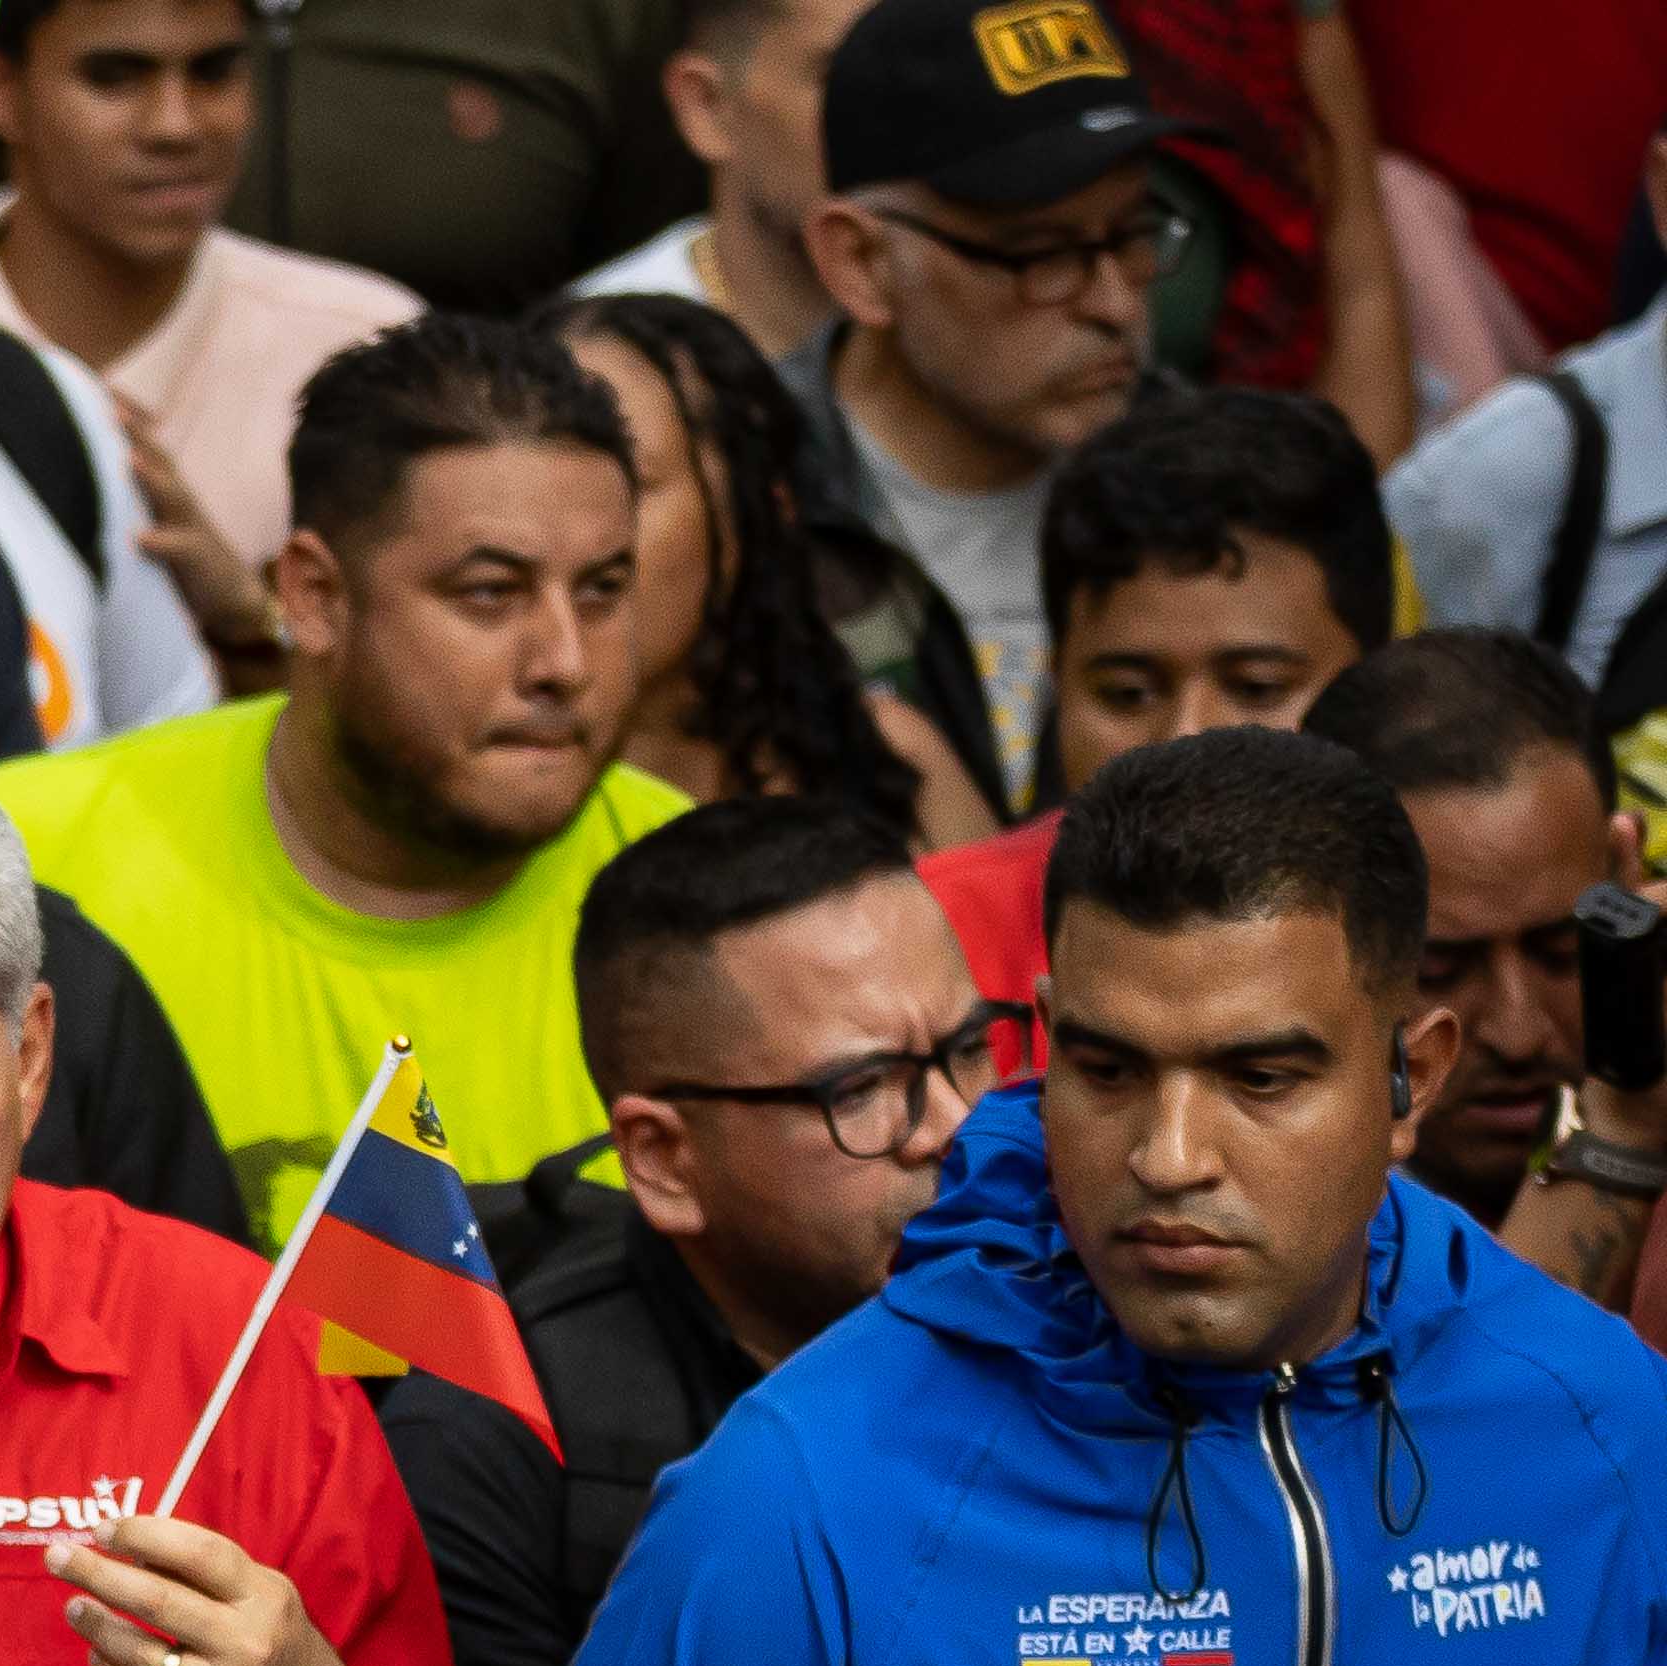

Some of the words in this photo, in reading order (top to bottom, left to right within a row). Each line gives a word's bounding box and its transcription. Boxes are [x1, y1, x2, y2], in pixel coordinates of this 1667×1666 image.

[1410, 1540, 1510, 1591] amor
[1018, 1605, 1044, 1624] LA
[1048, 1589, 1231, 1624] ESPERANZA
[1432, 1578, 1546, 1638] PATRIA
[1018, 1628, 1079, 1655] ESTÁ
[1084, 1631, 1115, 1654] EN
[1158, 1624, 1232, 1652] CALLE
